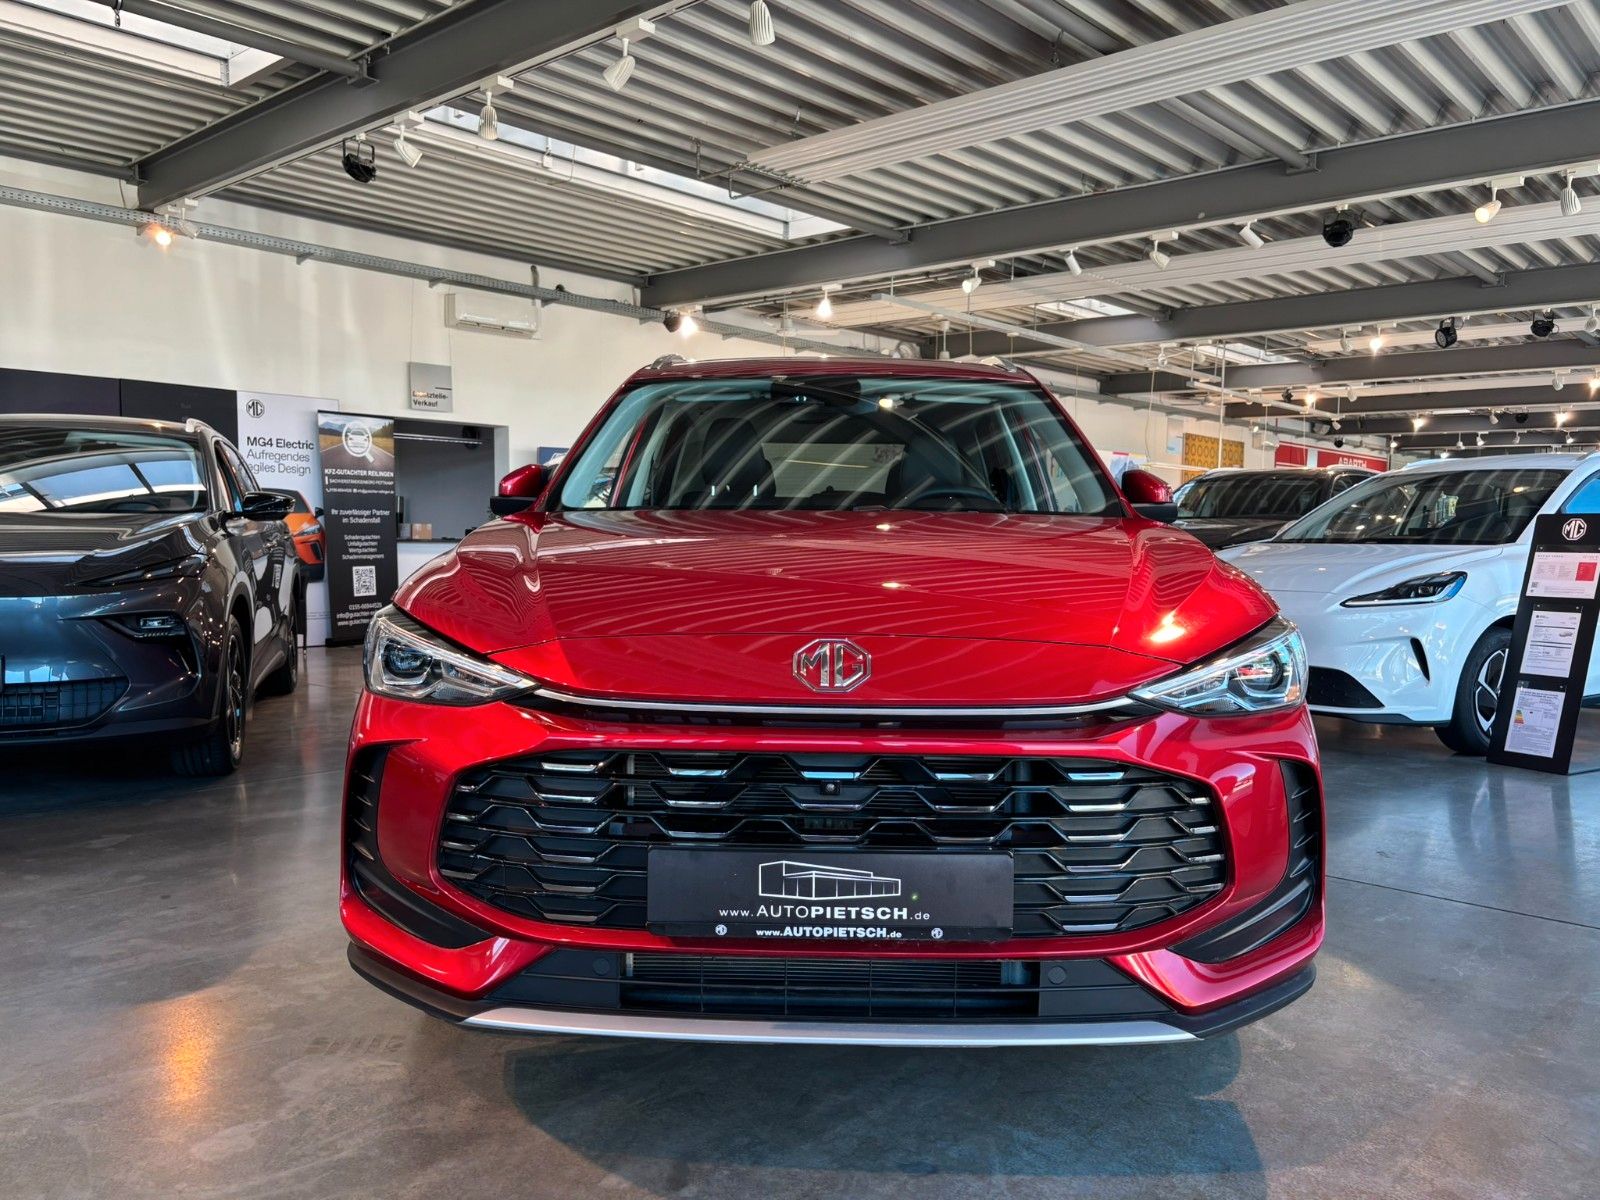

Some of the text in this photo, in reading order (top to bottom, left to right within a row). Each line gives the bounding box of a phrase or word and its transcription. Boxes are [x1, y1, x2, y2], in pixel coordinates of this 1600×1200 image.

[247, 400, 264, 418] MG
[413, 399, 438, 407] Verkauf
[246, 436, 315, 450] MG4 Electric
[246, 449, 310, 463] Aufregendes
[1338, 456, 1367, 468] ABARTH
[277, 463, 311, 477] Design
[324, 468, 367, 476] KFZ-GUTACHTER
[1562, 518, 1587, 540] MG
[795, 639, 869, 691] MG
[718, 904, 930, 920] www.AUTOPIETSCH.de
[756, 926, 902, 939] www.AUTOPIETSCH.de
